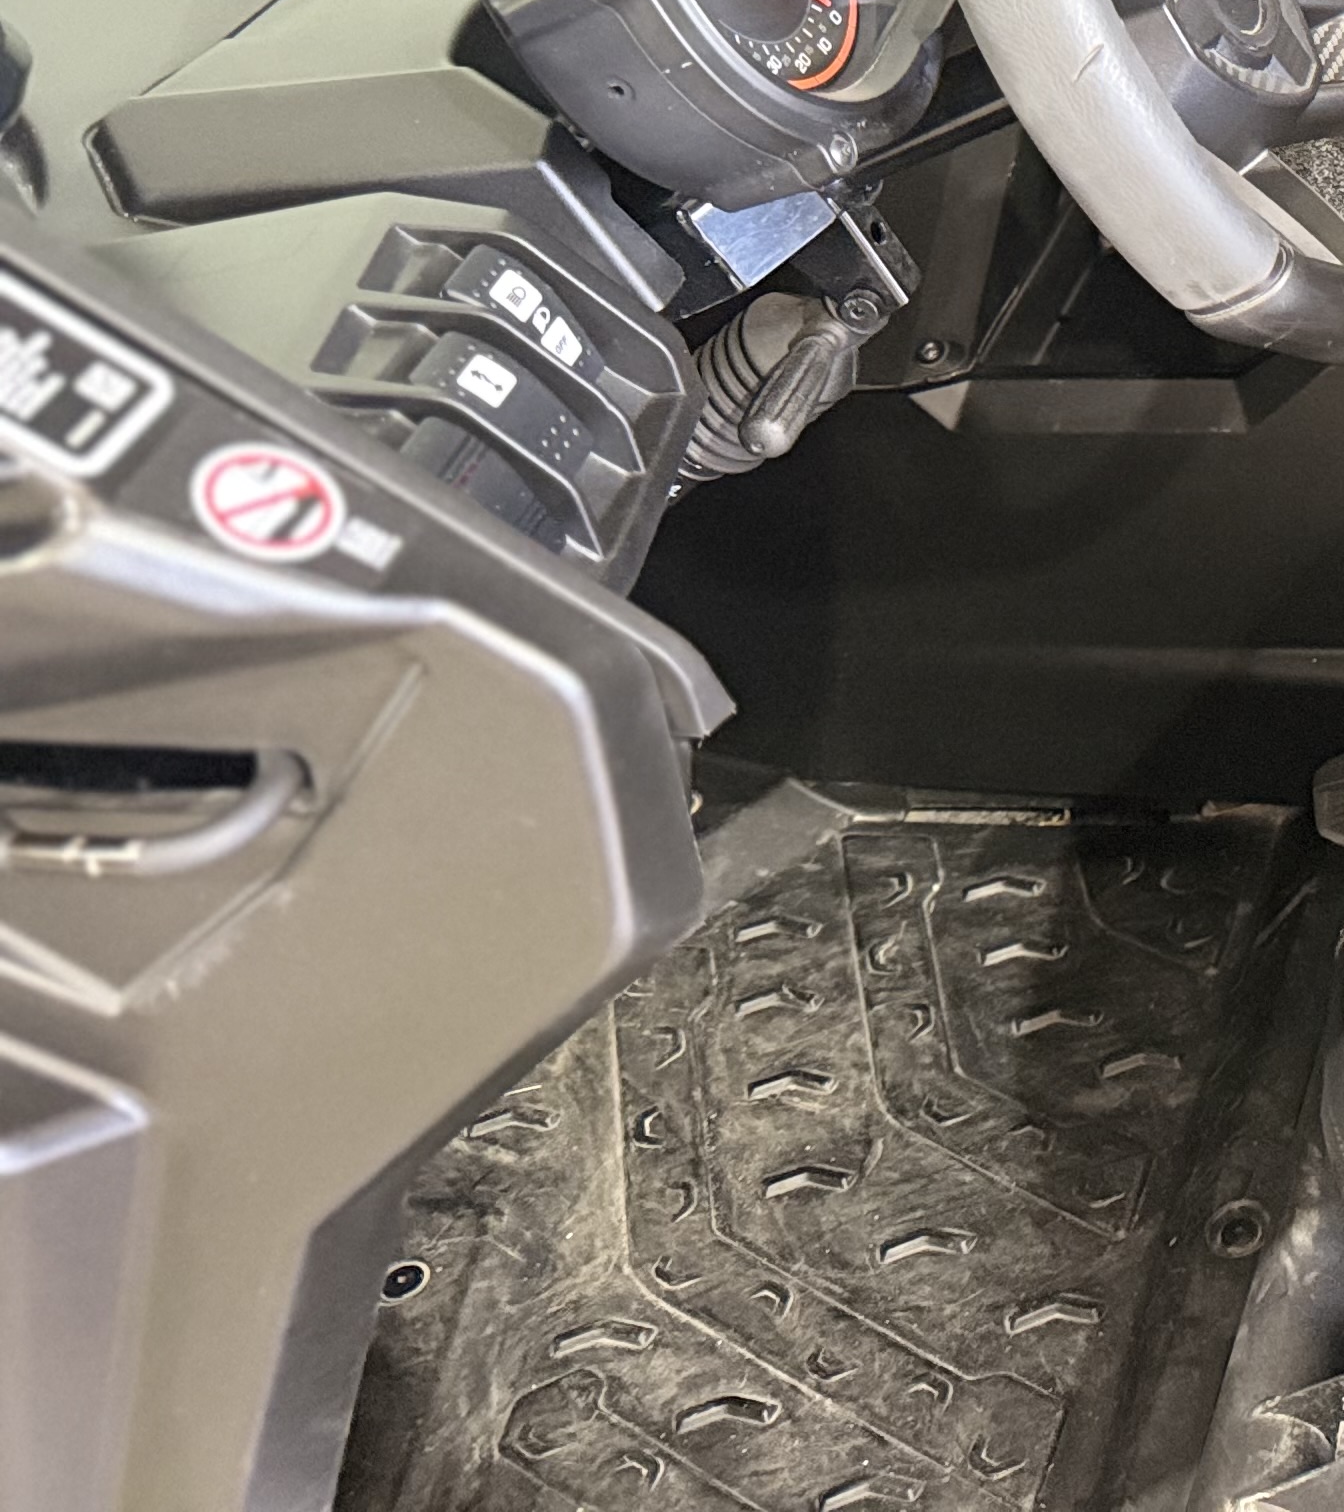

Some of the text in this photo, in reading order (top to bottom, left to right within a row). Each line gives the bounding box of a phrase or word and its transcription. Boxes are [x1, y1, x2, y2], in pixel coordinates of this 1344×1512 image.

[828, 9, 842, 26] 0
[816, 36, 832, 55] 10
[766, 54, 783, 76] 30
[794, 52, 812, 74] 20
[555, 335, 568, 355] OFF
